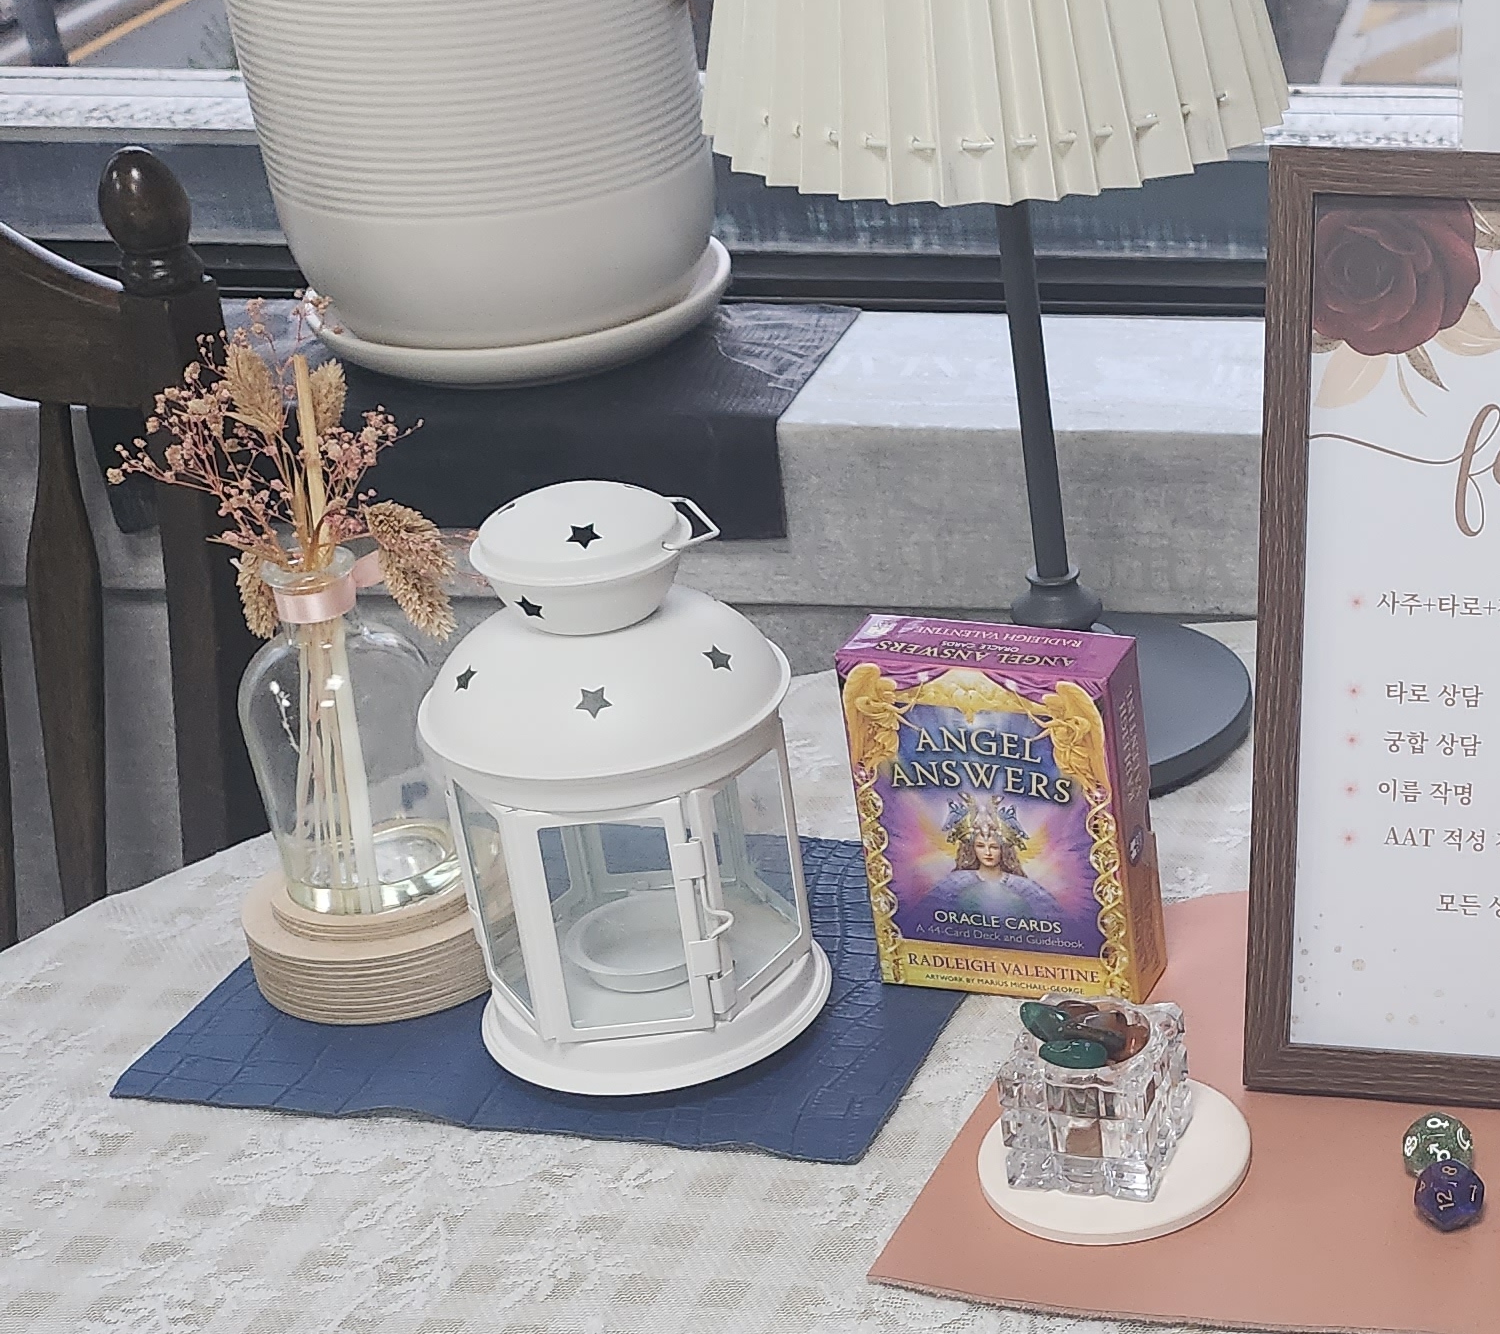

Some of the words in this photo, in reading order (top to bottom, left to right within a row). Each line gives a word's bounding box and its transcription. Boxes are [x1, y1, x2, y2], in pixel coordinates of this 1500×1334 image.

[876, 639, 991, 663] ANSWERS
[941, 640, 983, 650] CARDS
[988, 643, 1020, 653] ORACLE
[1002, 632, 1083, 649] RADLEIGH
[999, 653, 1077, 667] ANGEL
[1385, 680, 1431, 705] 타로
[1437, 683, 1484, 708] 상담
[915, 726, 1043, 764] ANGEL
[1383, 730, 1429, 755] 궁합
[1435, 732, 1482, 758] 상담
[891, 759, 1071, 804] ANSWERS
[1378, 778, 1423, 803] 이름
[1428, 781, 1473, 806] 작명
[1383, 826, 1435, 848] AAT
[1442, 827, 1486, 853] 적성
[1435, 893, 1482, 917] 모든
[933, 910, 1001, 928] ORACLE
[1004, 916, 1062, 934] CARDS
[928, 926, 971, 939] 44-Card
[973, 929, 1001, 941] Deck
[1003, 933, 1023, 943] and
[1026, 935, 1085, 949] Guidebook
[907, 952, 996, 973] RADLEIGH
[1000, 961, 1100, 984] VALENTINE
[925, 973, 964, 983] ARTWORK
[977, 978, 1009, 988] MARIUS
